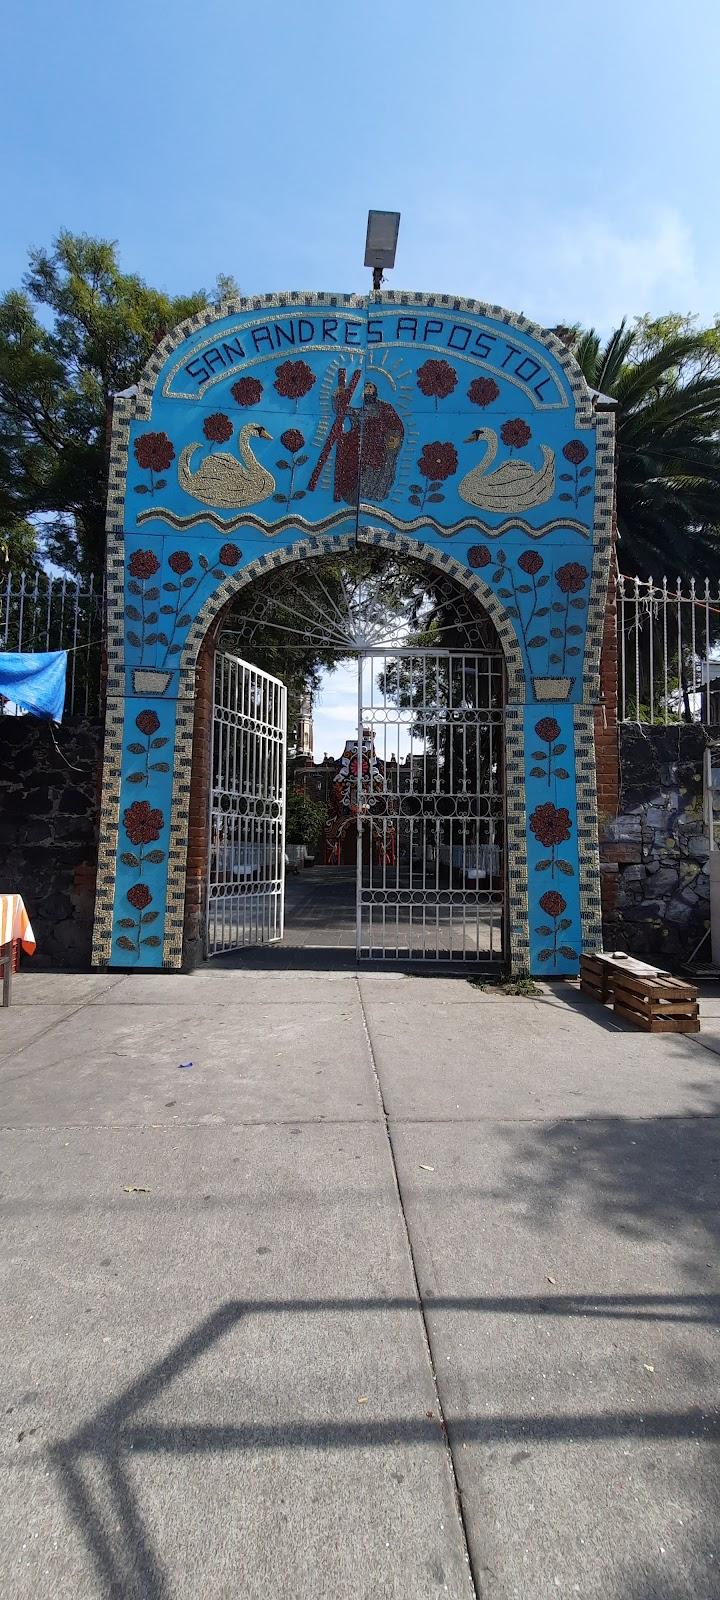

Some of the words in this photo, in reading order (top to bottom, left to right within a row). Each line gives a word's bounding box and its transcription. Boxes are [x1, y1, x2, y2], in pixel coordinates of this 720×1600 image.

[185, 337, 245, 386] SAN
[252, 318, 383, 354] ANDRES
[396, 317, 552, 401] APOSTOL
